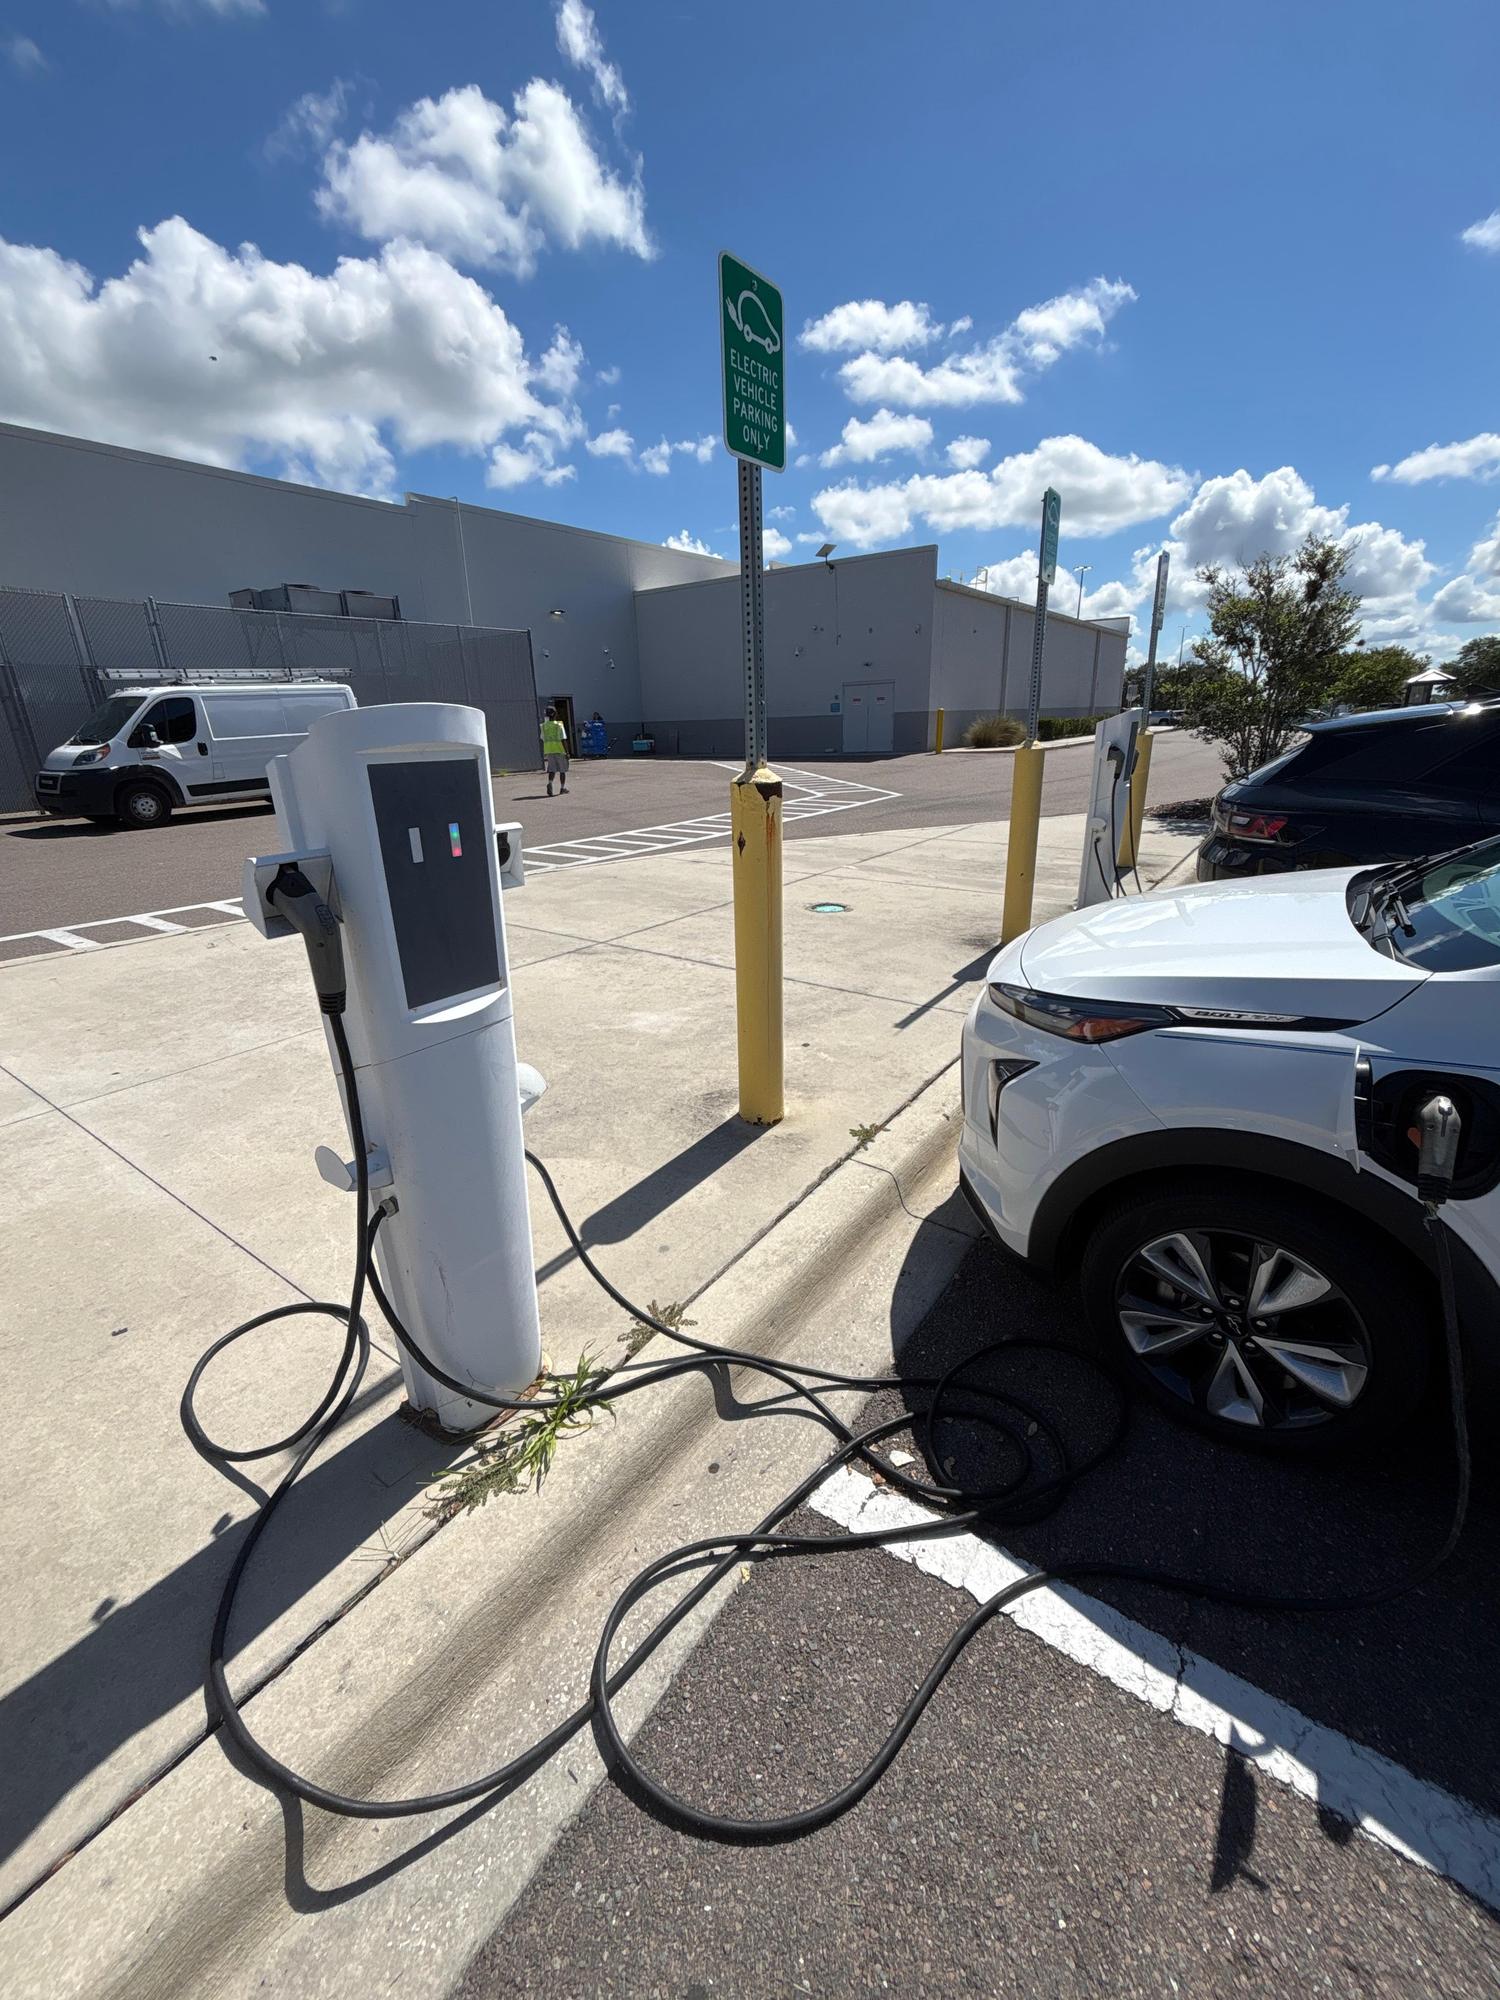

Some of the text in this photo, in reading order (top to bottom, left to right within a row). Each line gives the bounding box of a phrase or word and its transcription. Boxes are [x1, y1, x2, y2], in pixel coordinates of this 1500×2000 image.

[730, 348, 778, 389] ELECTRIC
[734, 373, 776, 411] VEHICLE
[734, 397, 777, 432] PARKING
[743, 425, 770, 450] ONLY
[1195, 1010, 1247, 1019] BOLT
